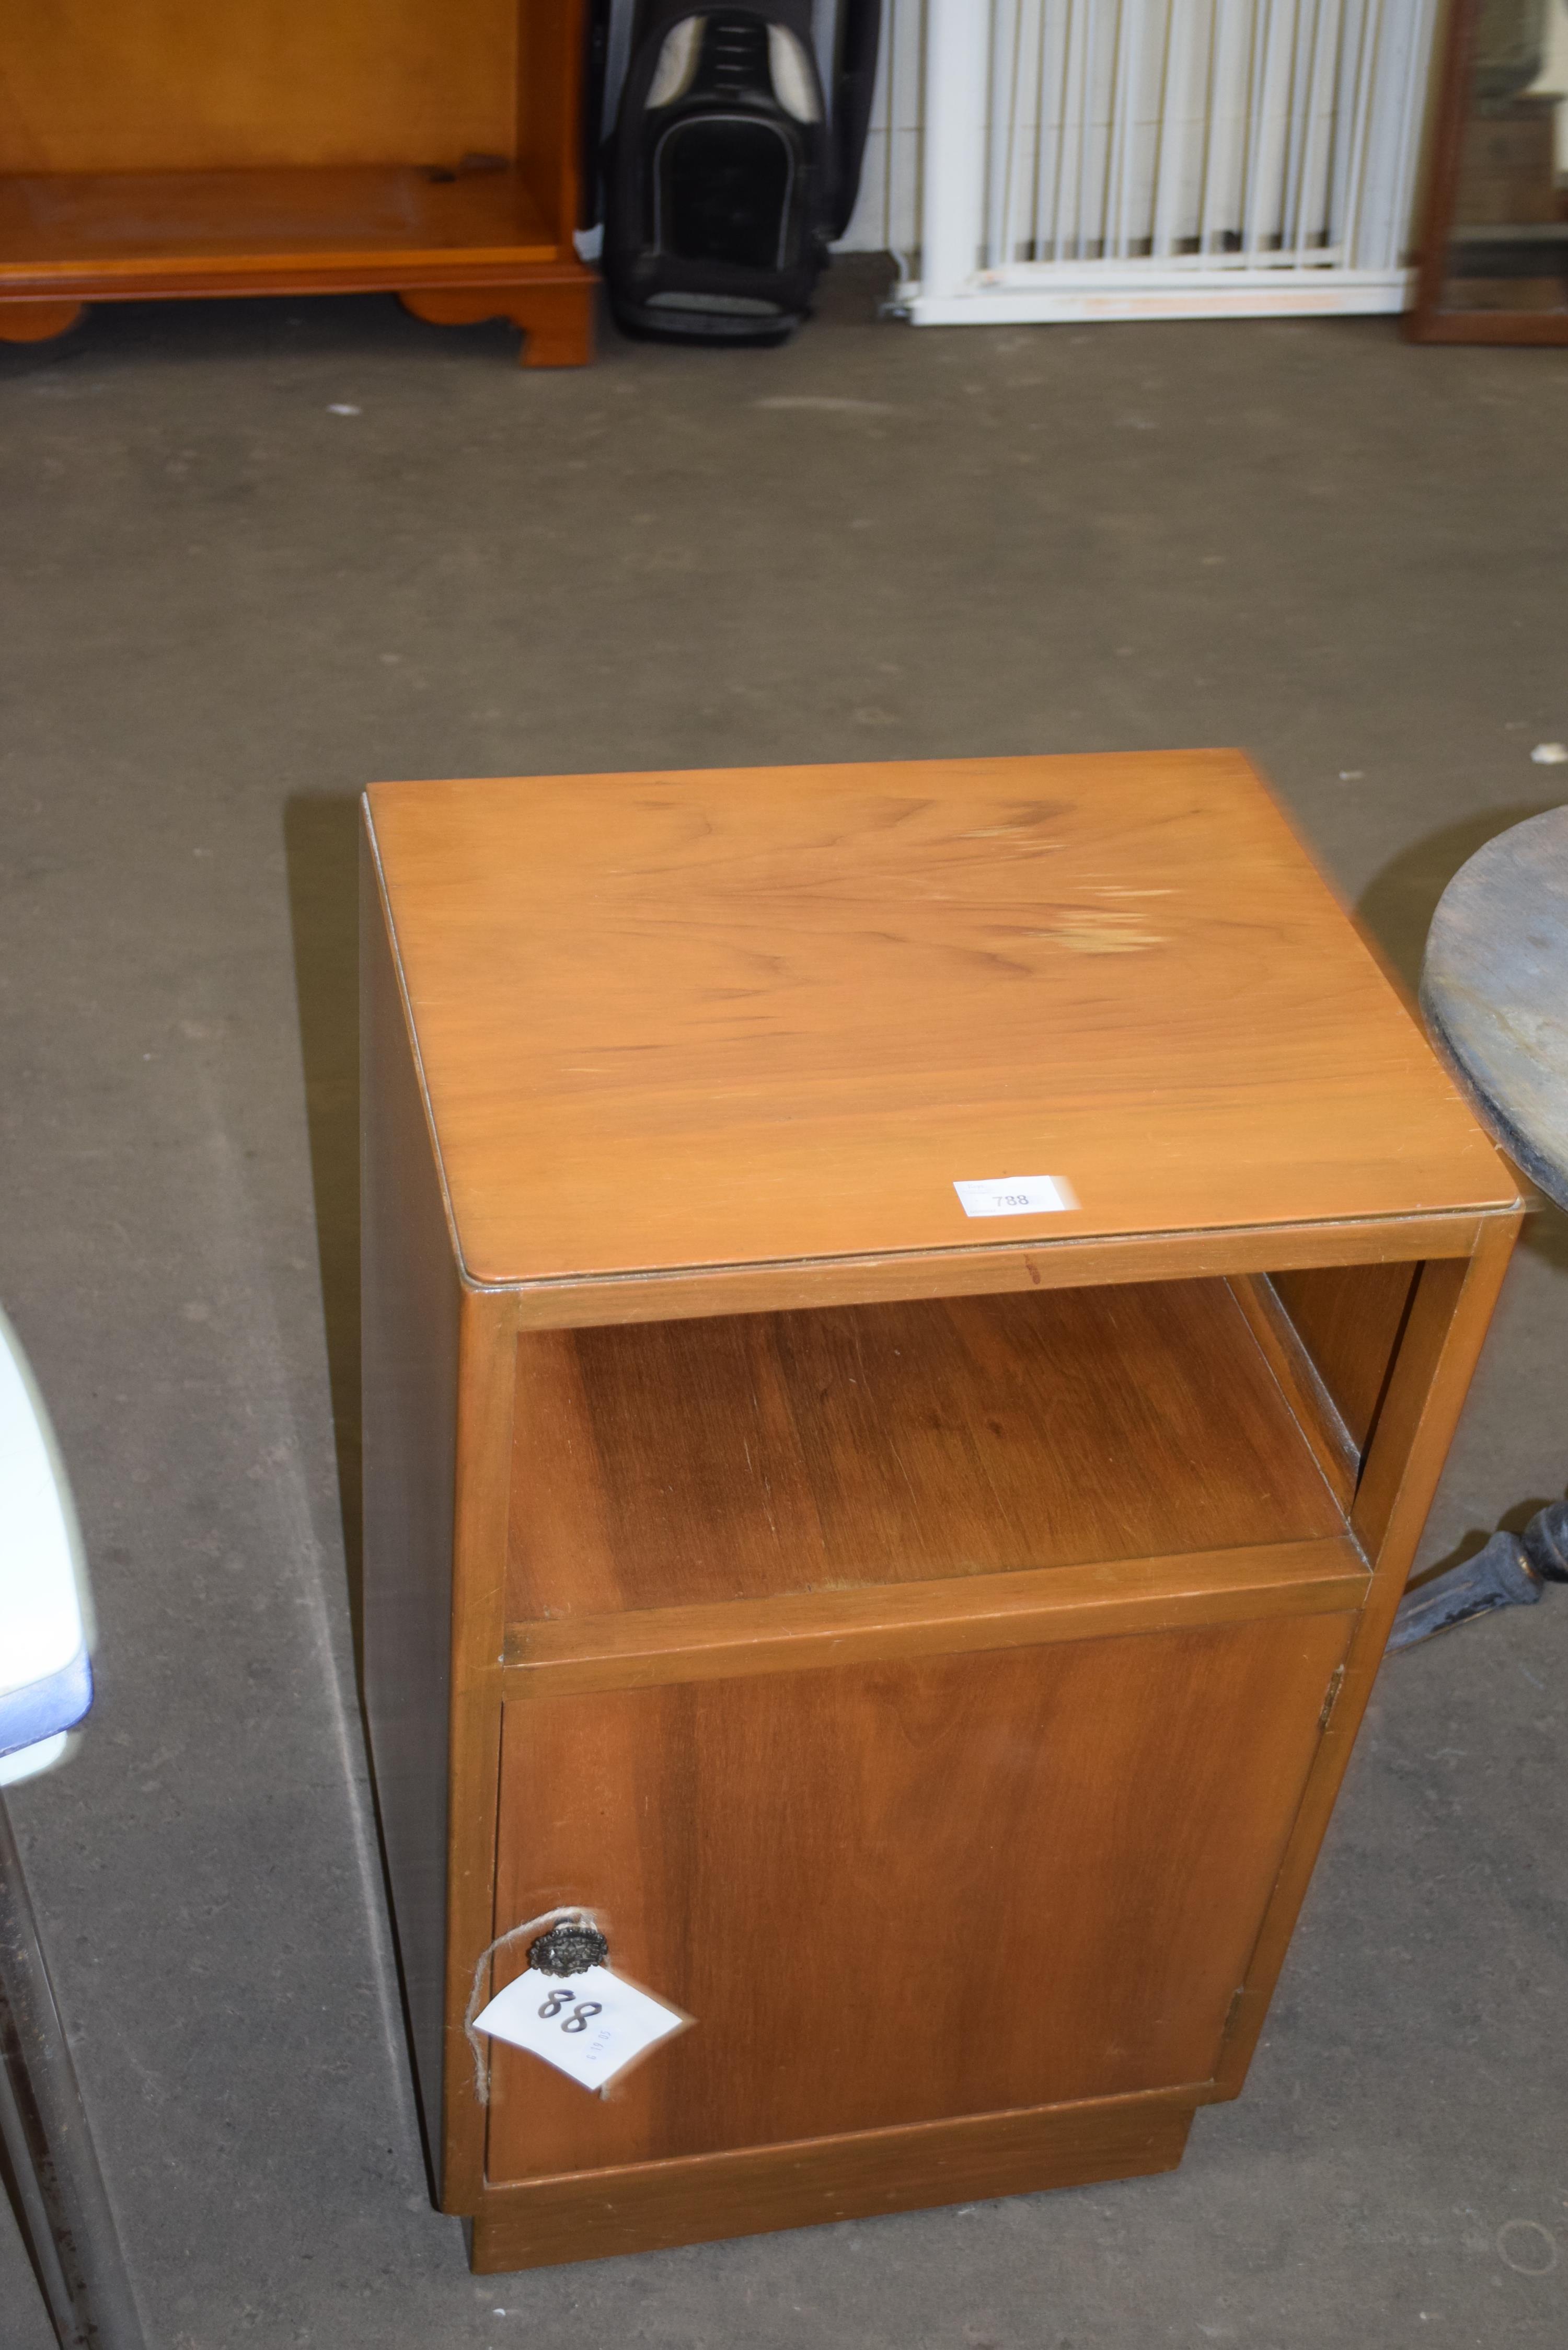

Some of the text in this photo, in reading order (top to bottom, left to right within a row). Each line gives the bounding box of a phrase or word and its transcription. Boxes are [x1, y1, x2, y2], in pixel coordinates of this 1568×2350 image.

[993, 1195, 1029, 1206] 788
[538, 1989, 602, 2033] 88
[591, 2042, 603, 2051] 19
